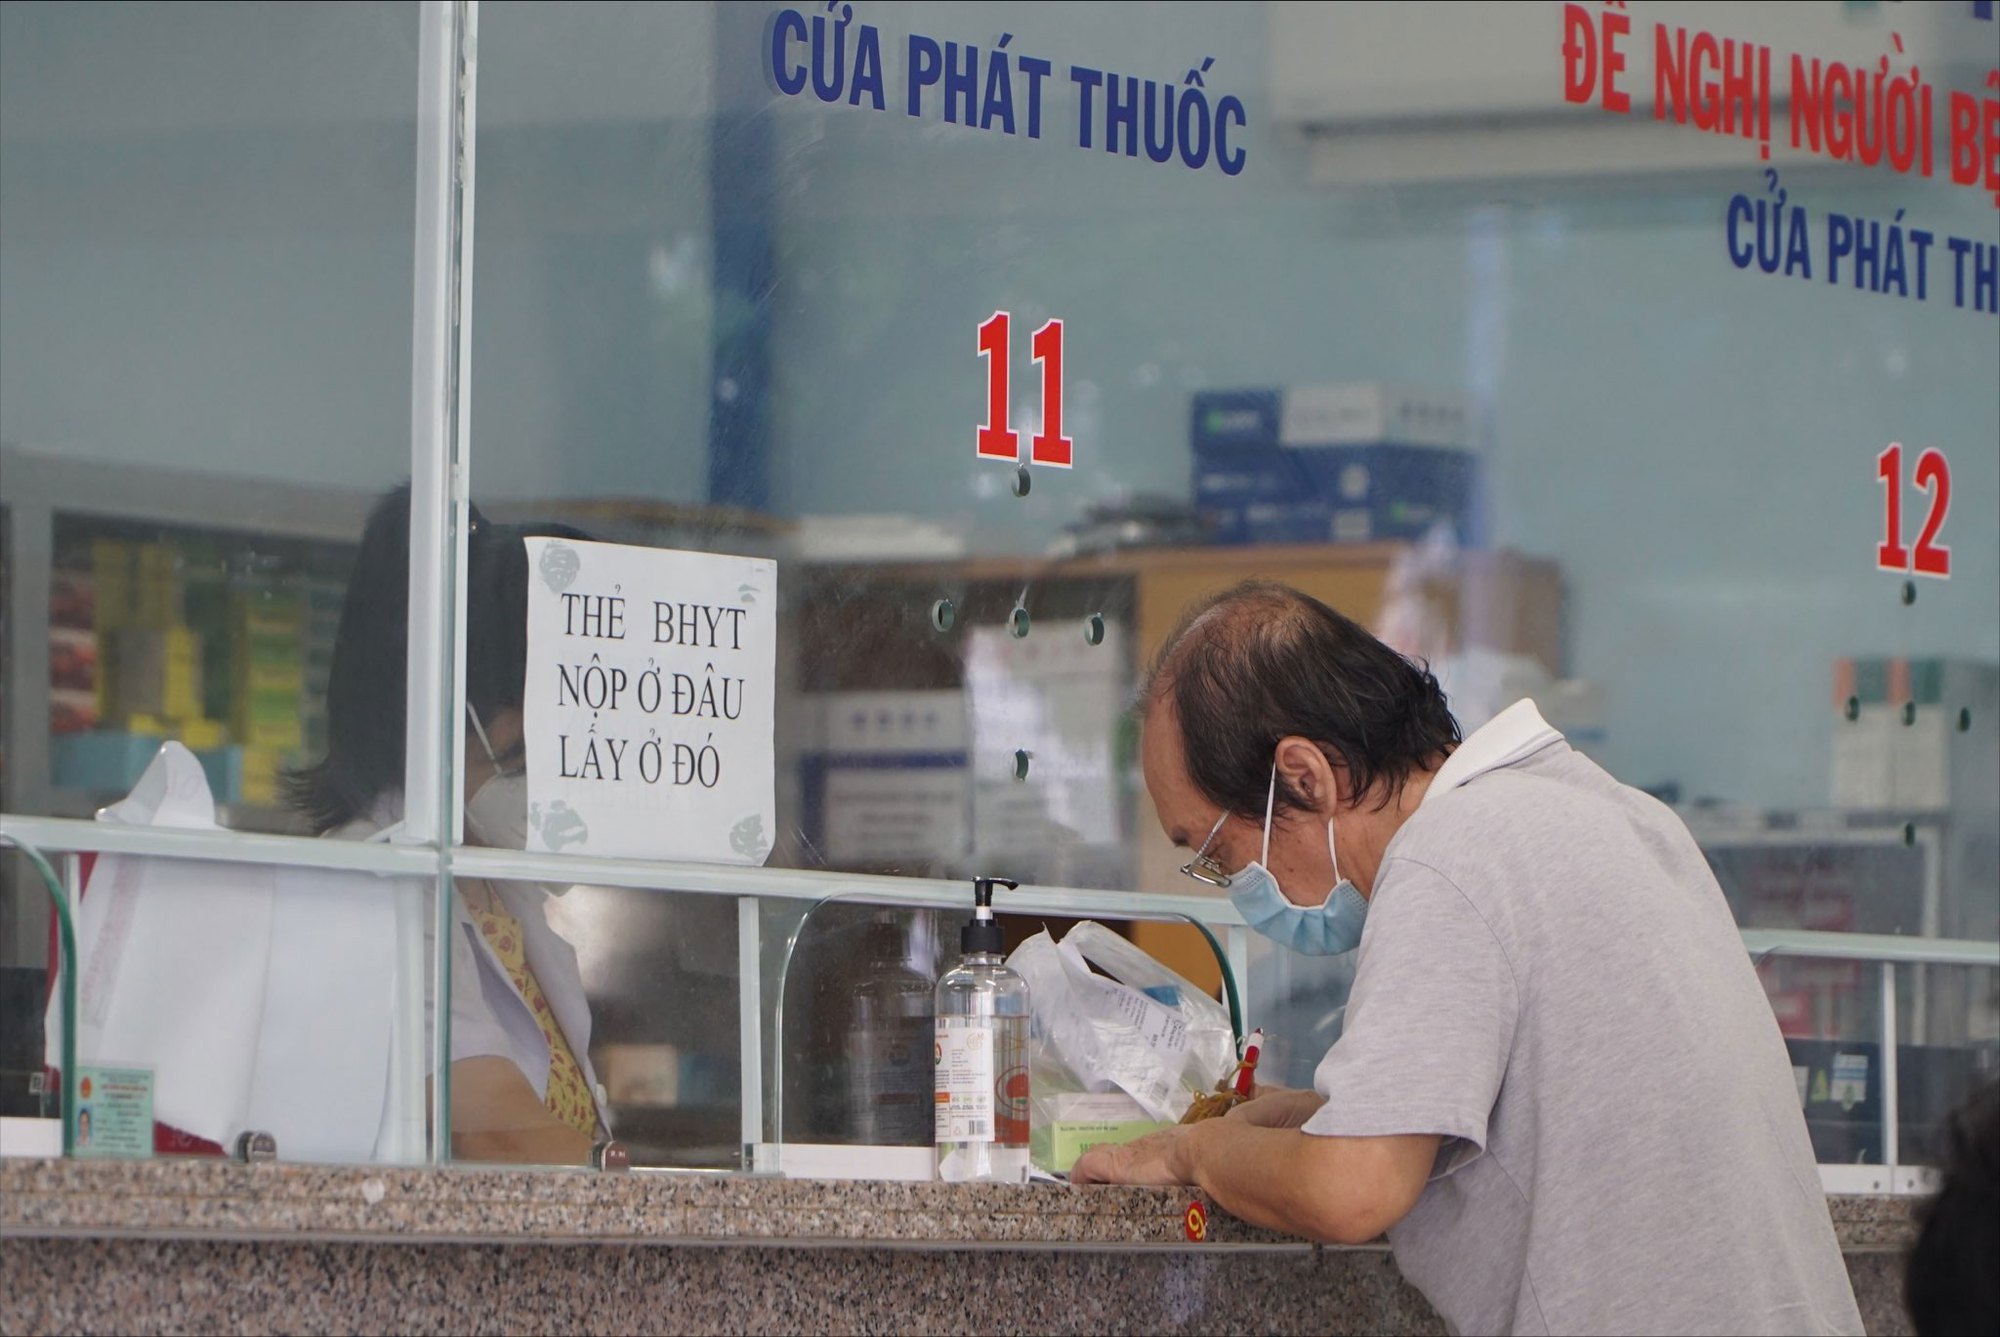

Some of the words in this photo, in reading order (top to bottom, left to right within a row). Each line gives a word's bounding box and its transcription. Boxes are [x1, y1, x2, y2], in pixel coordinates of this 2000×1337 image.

[907, 33, 1051, 139] PHÁT
[1070, 57, 1247, 177] THUỐC
[1654, 22, 1771, 160] NGHỊ
[1790, 31, 1934, 178] NGƯỜI
[1727, 168, 1812, 280] CỬA
[1827, 209, 1934, 301] PHÁT
[1947, 235, 1999, 314] TH
[977, 310, 1073, 469] 11
[1877, 441, 1951, 580] 12
[557, 653, 627, 718] NỘP
[637, 657, 661, 713] Ở
[672, 662, 745, 720] ĐÂU
[561, 584, 626, 640] THẺ
[653, 601, 746, 650] BHYT
[558, 723, 629, 781] LẤY
[639, 728, 662, 784] Ở
[672, 732, 720, 788] ĐÓ
